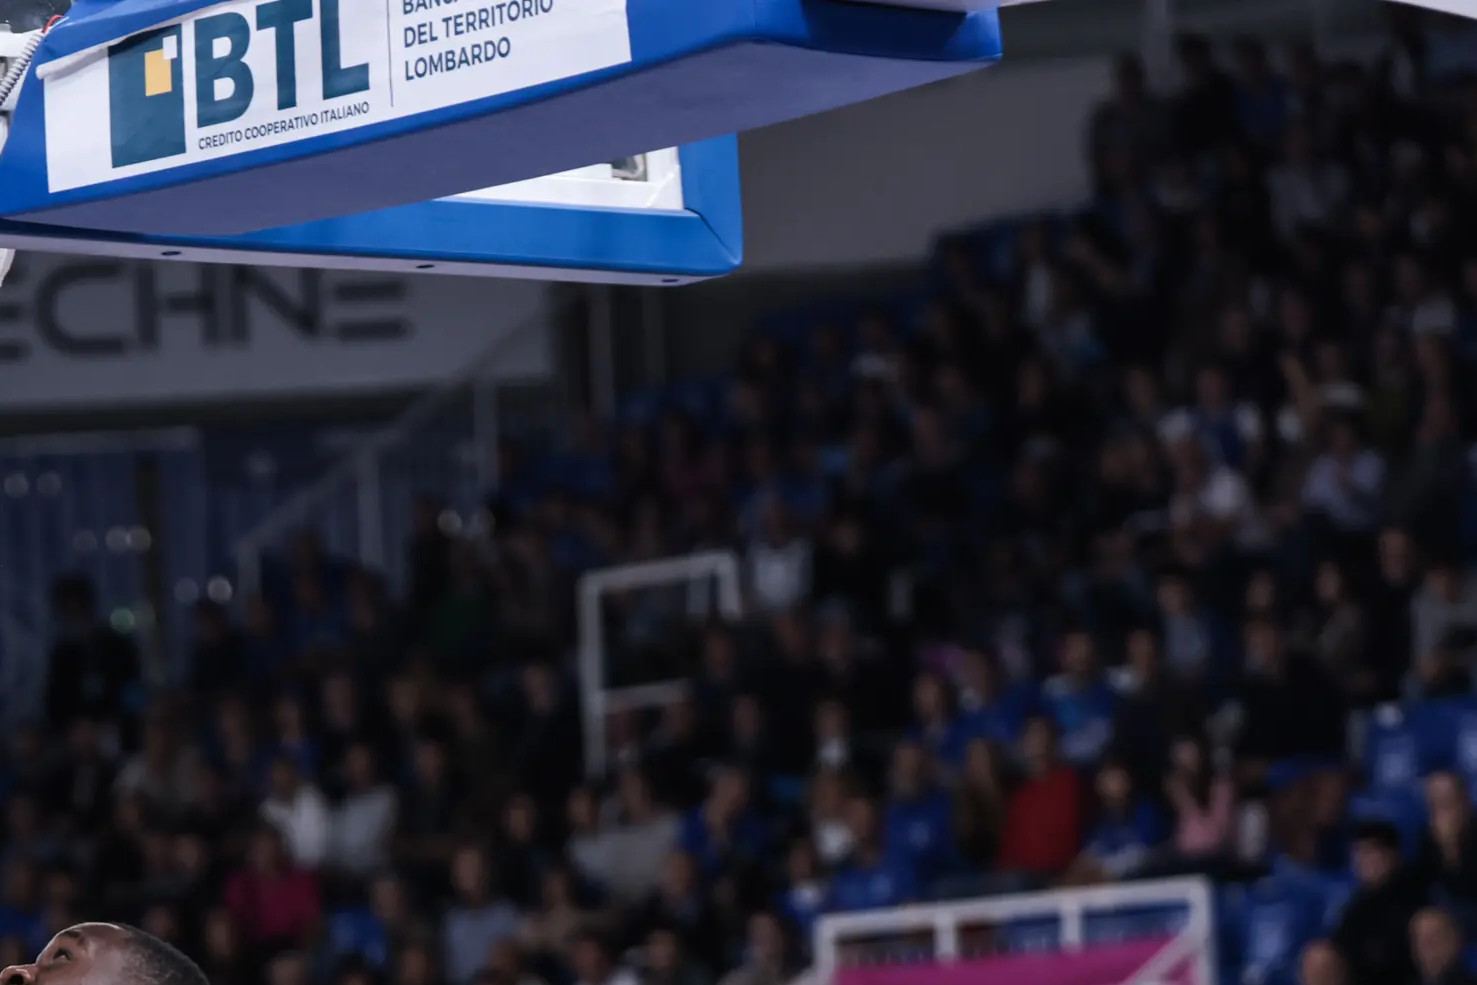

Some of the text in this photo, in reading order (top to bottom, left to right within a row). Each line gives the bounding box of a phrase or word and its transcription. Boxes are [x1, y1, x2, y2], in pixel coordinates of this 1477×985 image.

[403, 0, 554, 48] DEL TERRITORIO
[194, 0, 370, 128] BTL
[405, 37, 511, 81] LOMBARDO
[198, 101, 370, 150] CREDITO COOPERATIVO ITALIANO
